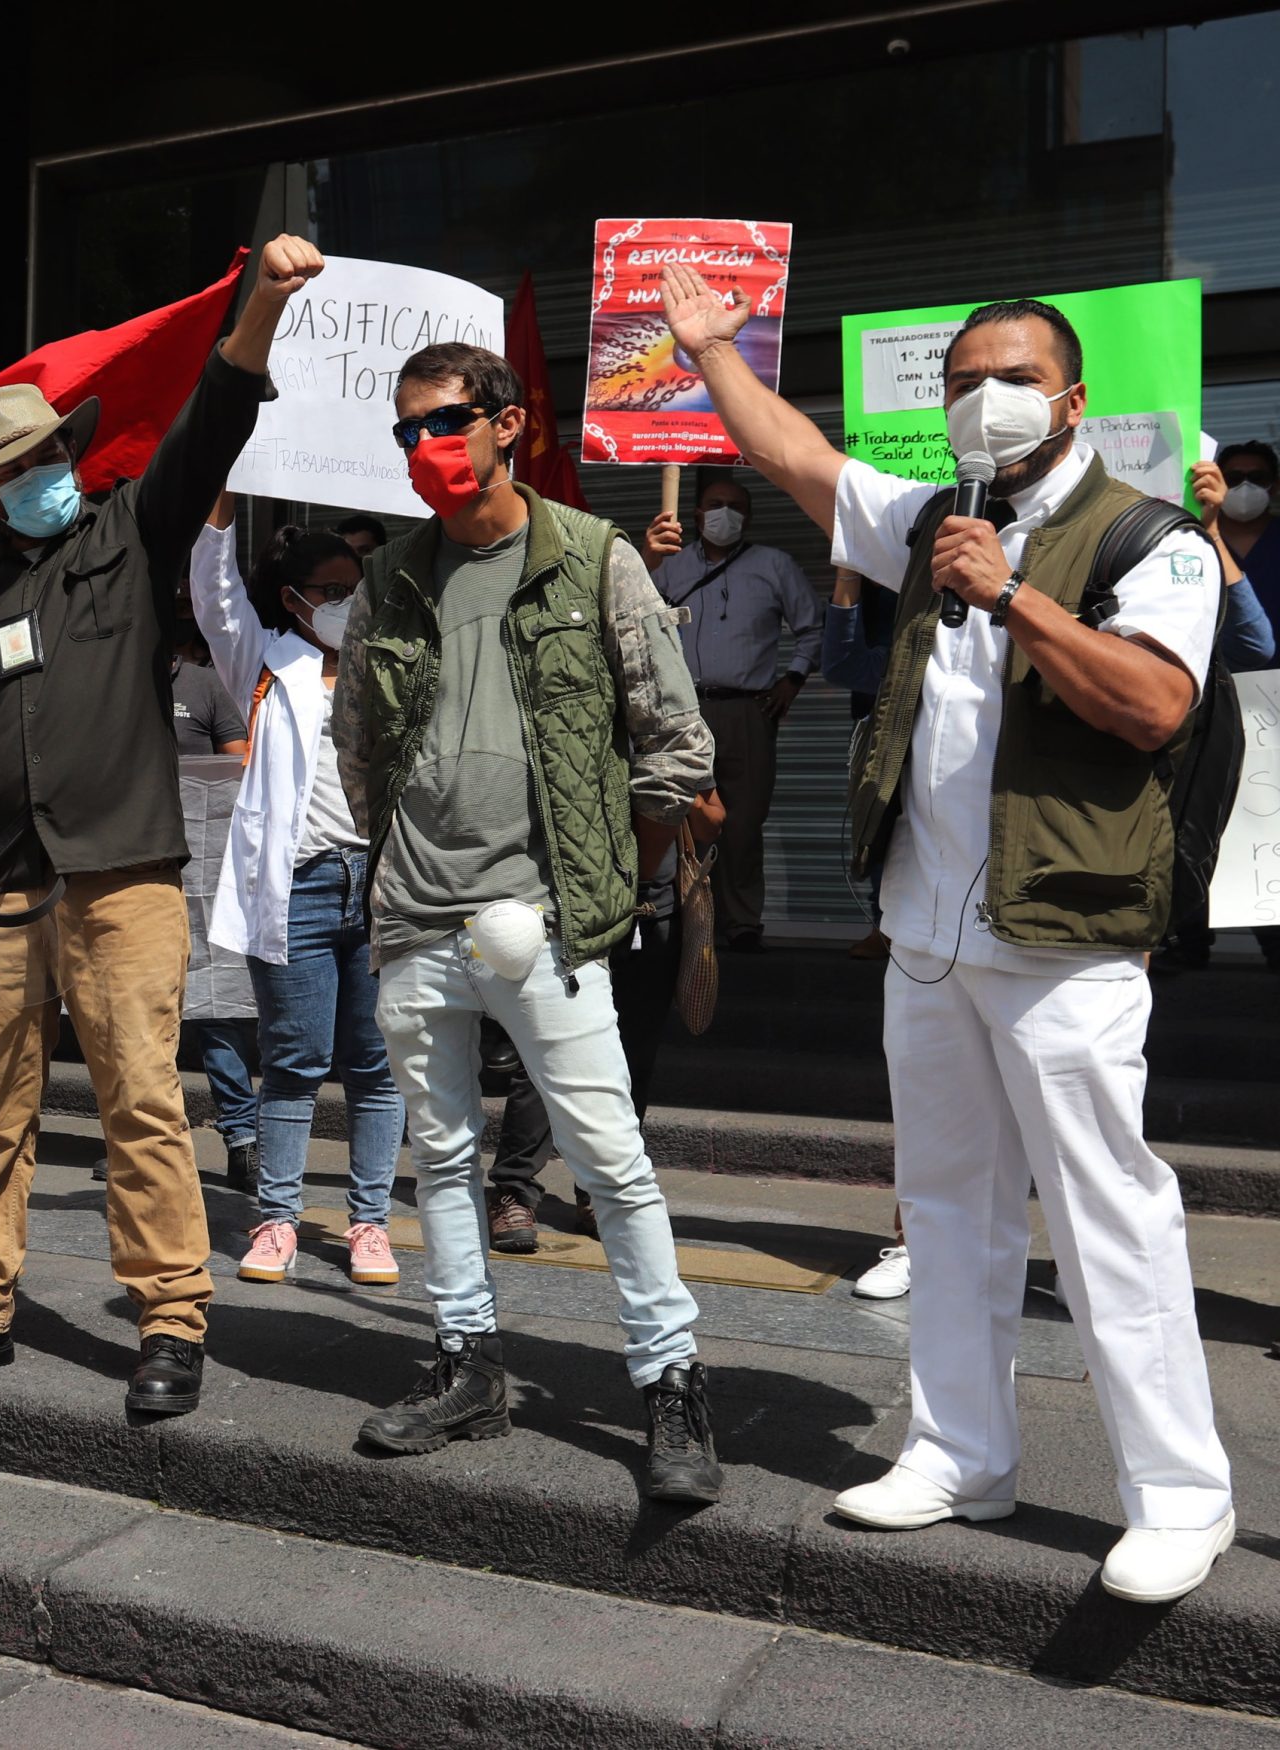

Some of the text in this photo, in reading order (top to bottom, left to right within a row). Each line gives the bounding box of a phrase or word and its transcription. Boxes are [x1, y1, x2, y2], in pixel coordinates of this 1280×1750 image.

[627, 245, 755, 266] REVOLUCIÓN
[870, 331, 941, 345] TRABAJADORES
[924, 348, 946, 361] JU
[325, 350, 402, 402] TOT
[897, 372, 923, 382] CMN
[1103, 435, 1151, 450] LUCHA
[872, 446, 913, 460] Salud
[1171, 576, 1205, 587] IMSS
